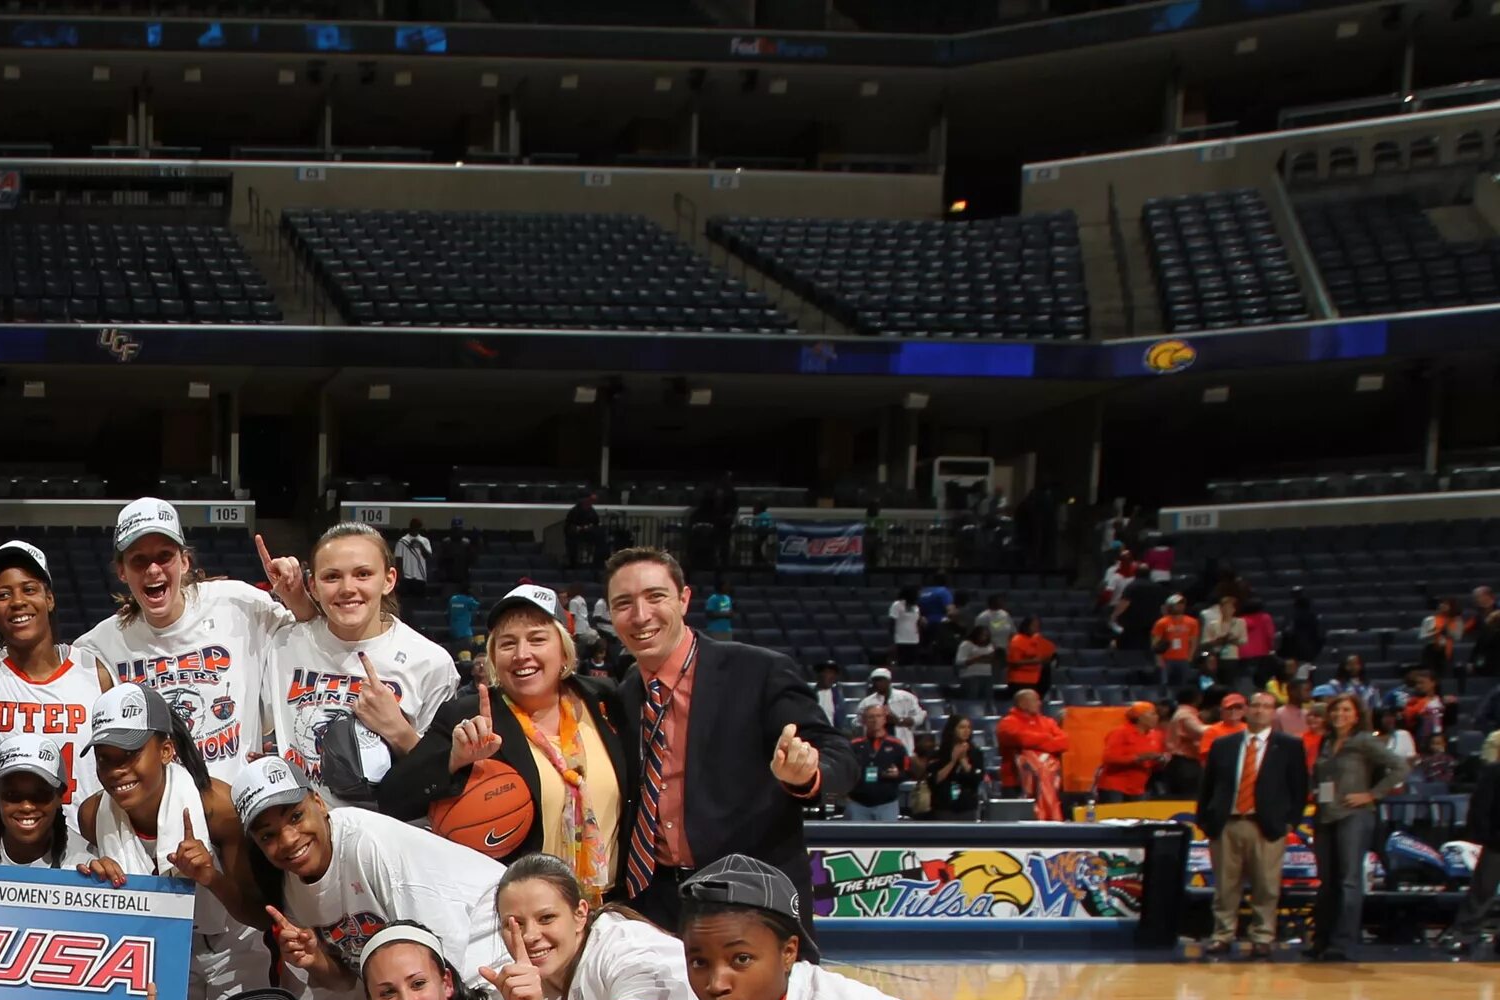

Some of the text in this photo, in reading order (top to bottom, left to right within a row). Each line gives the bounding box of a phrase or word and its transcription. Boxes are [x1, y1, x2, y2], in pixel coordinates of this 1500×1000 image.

[158, 510, 173, 522] UTEP
[216, 508, 238, 520] 105
[361, 509, 382, 522] 104
[533, 590, 552, 602] UTEP
[117, 645, 231, 684] UTEP
[150, 671, 220, 689] INERS
[122, 704, 143, 719] UTEP
[38, 749, 55, 761] UTEP
[268, 769, 287, 784] UTEP
[834, 880, 863, 895] THE
[65, 892, 151, 912] BASKETBALL
[889, 879, 995, 917] Tulsa
